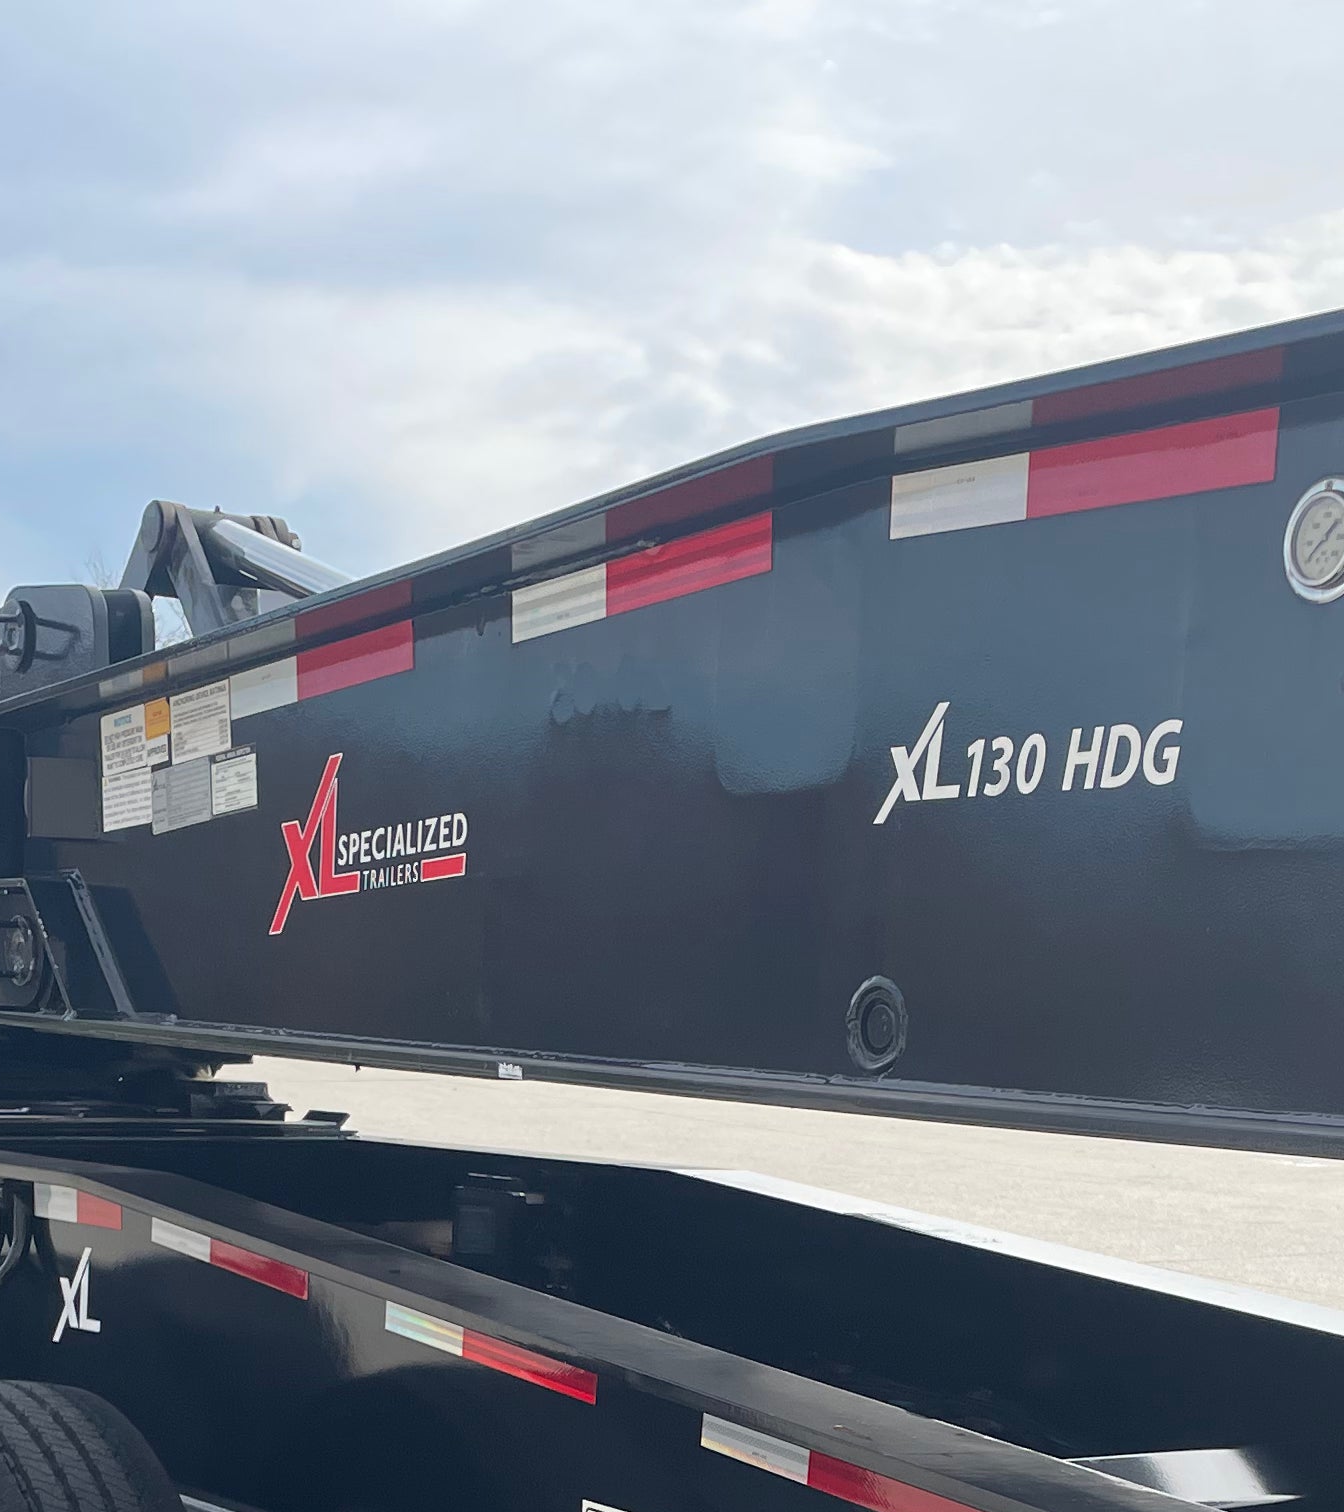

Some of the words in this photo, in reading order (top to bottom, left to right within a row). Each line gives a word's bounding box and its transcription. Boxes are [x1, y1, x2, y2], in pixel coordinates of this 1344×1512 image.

[1061, 718, 1184, 792] HDG
[268, 753, 361, 936] XL
[337, 812, 468, 866] SPECIALIZED
[363, 861, 420, 891] TRAILERS
[53, 1247, 101, 1343] XL
